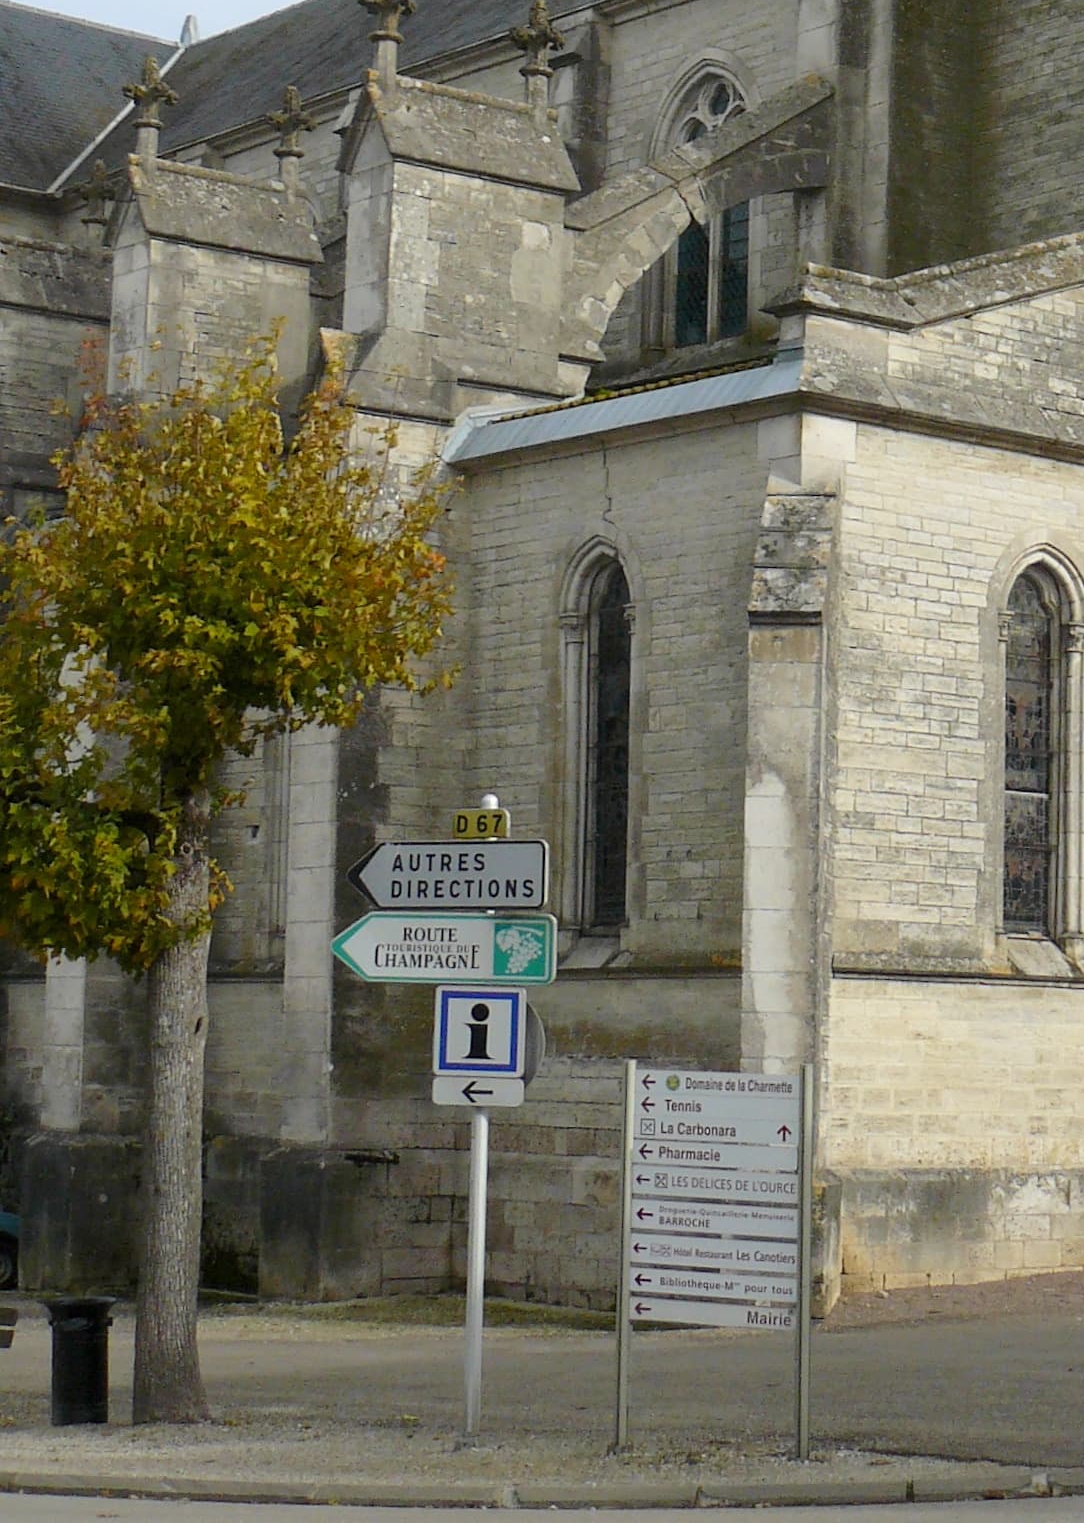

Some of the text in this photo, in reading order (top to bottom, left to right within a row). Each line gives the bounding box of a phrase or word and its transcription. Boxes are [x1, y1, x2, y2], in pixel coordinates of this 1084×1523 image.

[457, 814, 503, 833] D 67
[392, 853, 485, 872] AUTRES
[391, 879, 534, 899] DIRECTIONS
[403, 927, 458, 942] ROUTE
[374, 943, 480, 969] CHAMPAGNE
[386, 943, 471, 954] TOURISTIQUE DU
[685, 1077, 793, 1094] Domaine de la Charmette
[665, 1098, 702, 1113] Tennis
[660, 1121, 737, 1137] La Carbonara
[658, 1145, 721, 1162] Pharmacie
[671, 1176, 689, 1188] LES
[735, 1179, 749, 1192] DE
[752, 1180, 797, 1195] L'OURCE
[658, 1215, 711, 1228] BARROCHE
[736, 1249, 751, 1261] Les
[754, 1251, 796, 1265] Canotiers
[744, 1283, 767, 1295] pour
[771, 1285, 793, 1296] tous
[746, 1310, 792, 1326] Mairie
